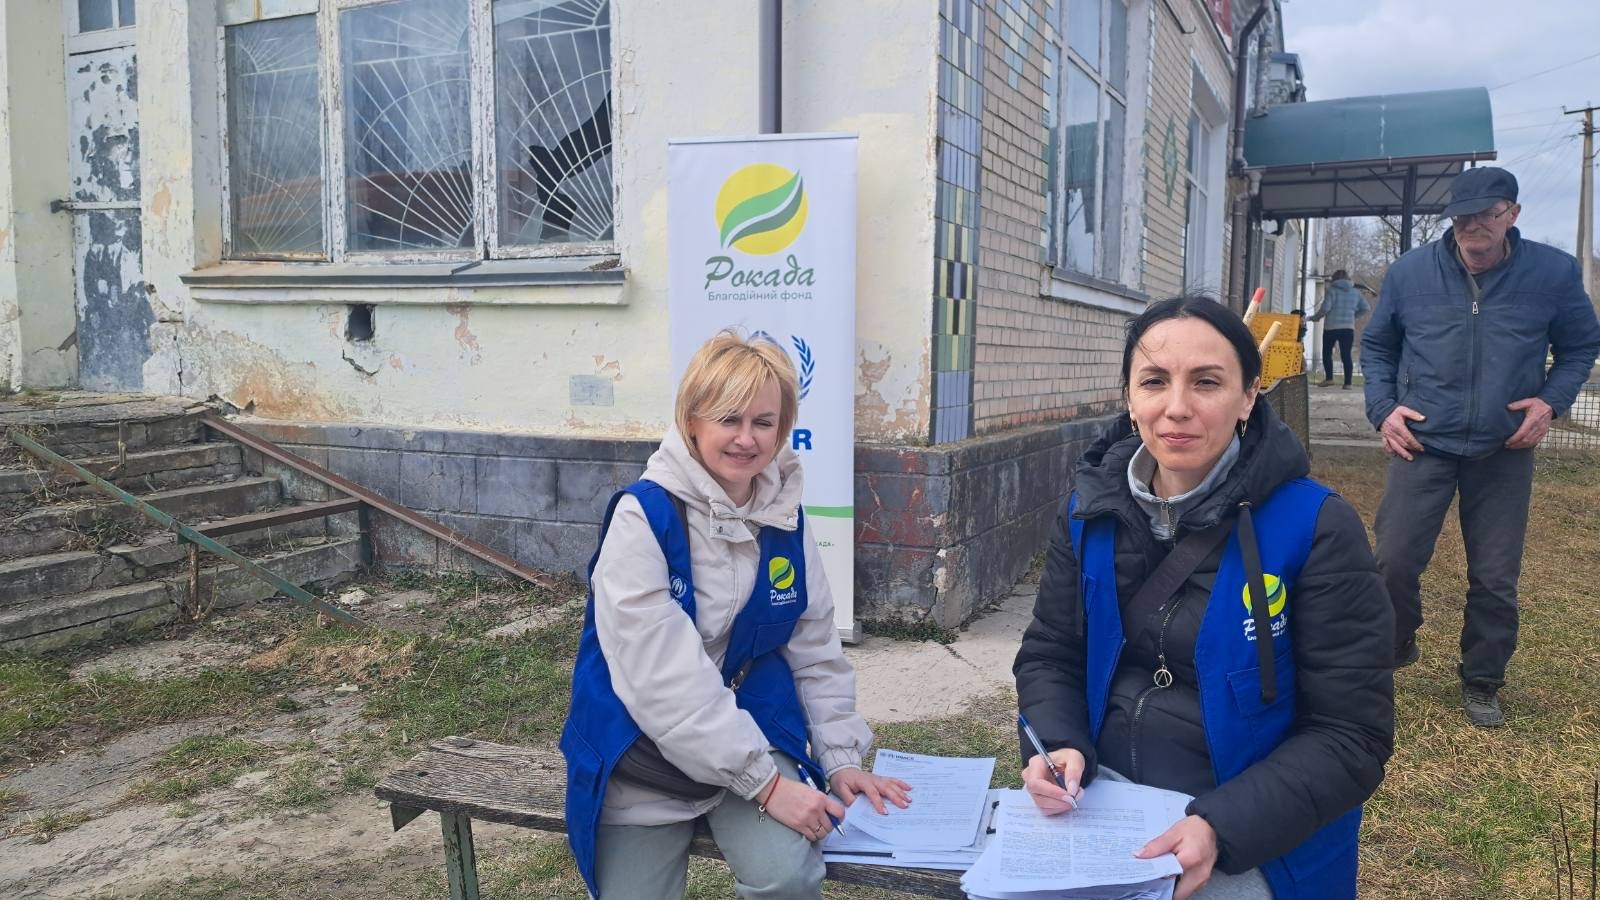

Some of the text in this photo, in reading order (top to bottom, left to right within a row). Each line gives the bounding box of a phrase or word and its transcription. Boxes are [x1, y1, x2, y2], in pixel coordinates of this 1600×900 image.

[704, 254, 817, 290] Рокада
[708, 290, 813, 302] Благодійний фонд
